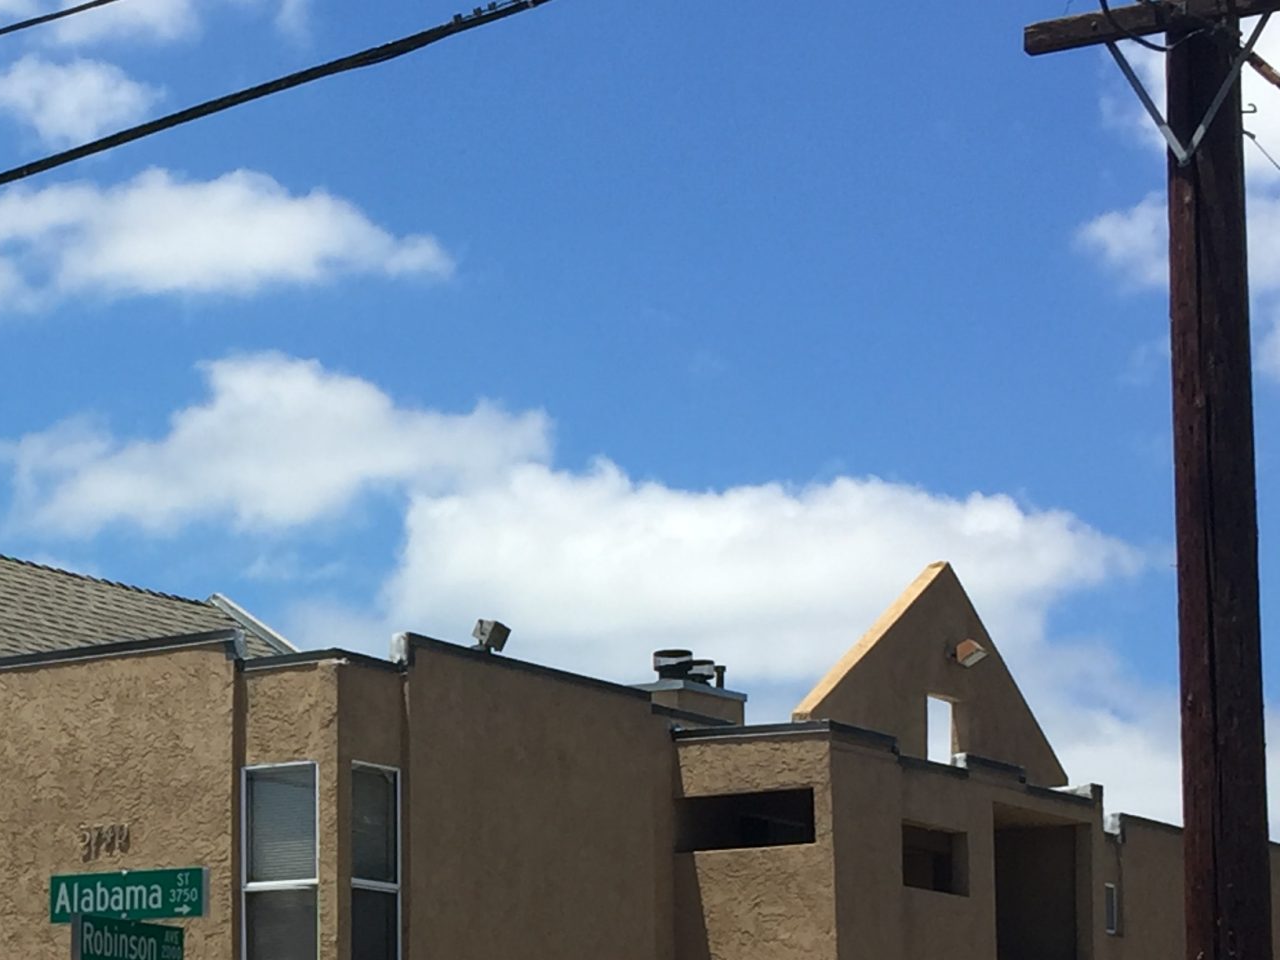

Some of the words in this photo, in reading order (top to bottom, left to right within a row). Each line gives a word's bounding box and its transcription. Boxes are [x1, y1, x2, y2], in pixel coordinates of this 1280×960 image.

[55, 881, 162, 914] Alabama
[176, 872, 190, 887] ST
[169, 887, 198, 903] 3750
